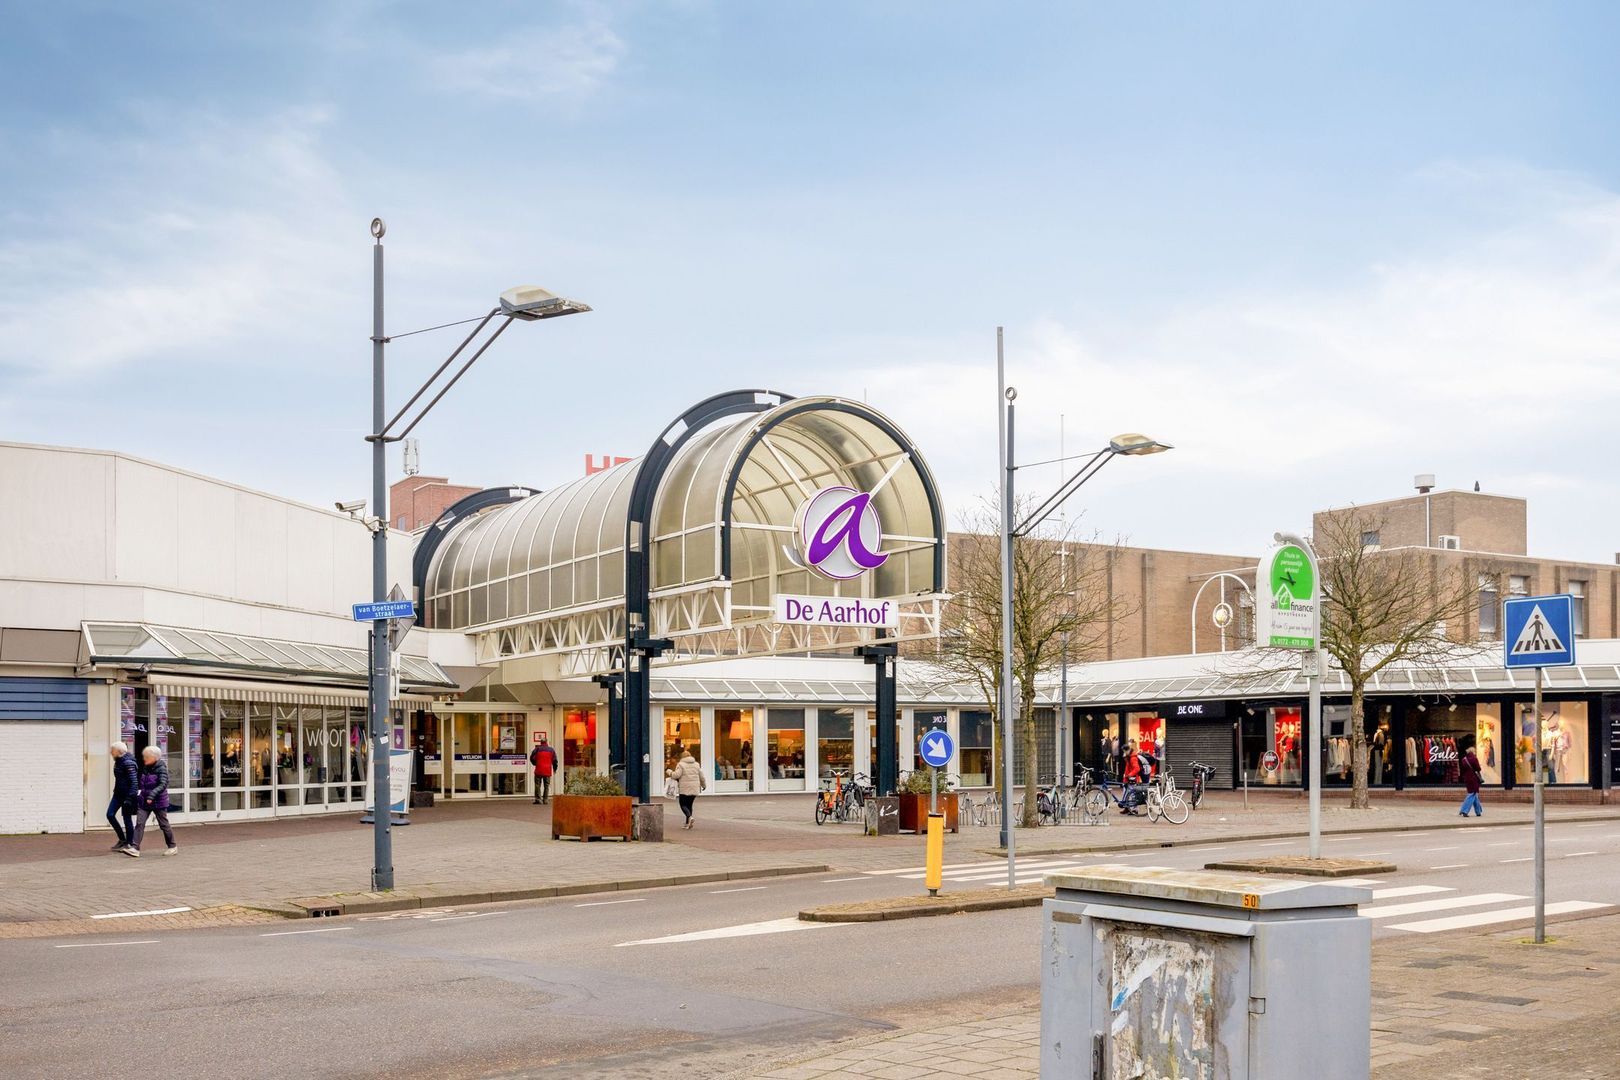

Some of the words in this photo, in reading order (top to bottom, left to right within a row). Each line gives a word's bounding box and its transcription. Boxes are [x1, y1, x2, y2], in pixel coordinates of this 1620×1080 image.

[786, 599, 814, 621] De
[818, 600, 890, 625] Aarhof
[1291, 602, 1314, 612] finance
[1177, 705, 1187, 714] BE
[1187, 705, 1203, 714] ONE
[1244, 894, 1256, 907] 50
